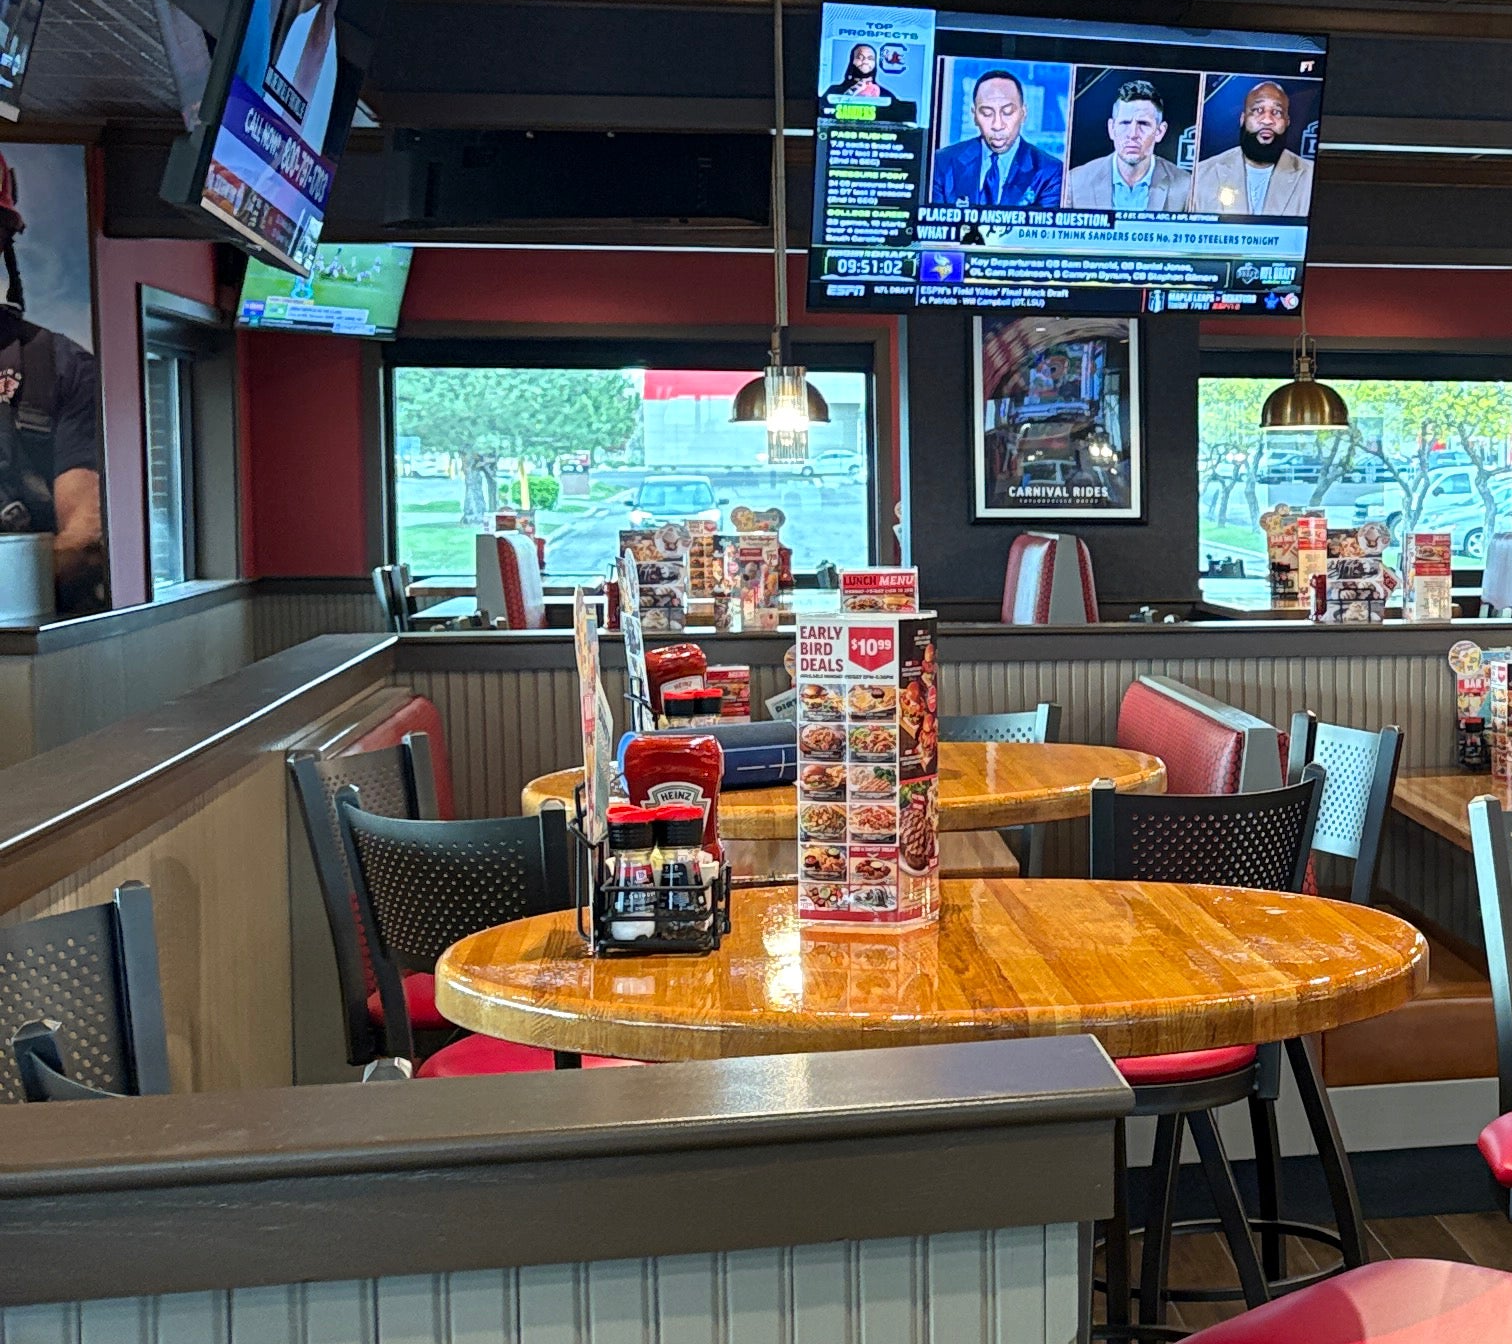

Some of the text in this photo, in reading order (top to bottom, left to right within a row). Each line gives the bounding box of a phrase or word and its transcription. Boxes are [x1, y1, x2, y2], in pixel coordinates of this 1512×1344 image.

[866, 22, 893, 30] TOP
[839, 29, 918, 40] PROSPECTS
[918, 208, 1111, 228] PLACED TO ANSWER THIS QUESTION.
[917, 225, 956, 240] WHAT I
[1019, 229, 1038, 238] DAN
[1057, 230, 1086, 240] THINK
[1088, 231, 1129, 242] SANDERS
[1132, 232, 1154, 242] GOES
[1184, 234, 1196, 244] TO
[1198, 234, 1240, 245] STEELERS
[1241, 236, 1280, 246] TONIGHT
[837, 259, 902, 274] 09:51:02
[970, 258, 990, 268] Key
[826, 284, 865, 296] ESPN
[953, 287, 974, 296] Field
[1001, 288, 1022, 296] Final
[1023, 288, 1046, 298] Mock
[1047, 289, 1069, 298] Draft
[1008, 486, 1109, 498] CARNIVAL RIDES
[843, 575, 914, 586] LUNCH MENU
[800, 626, 842, 640] EARLY
[800, 642, 833, 656] BIRD
[800, 658, 844, 672] DEALS
[673, 680, 692, 690] HEINZ
[661, 791, 692, 802] HEINZ
